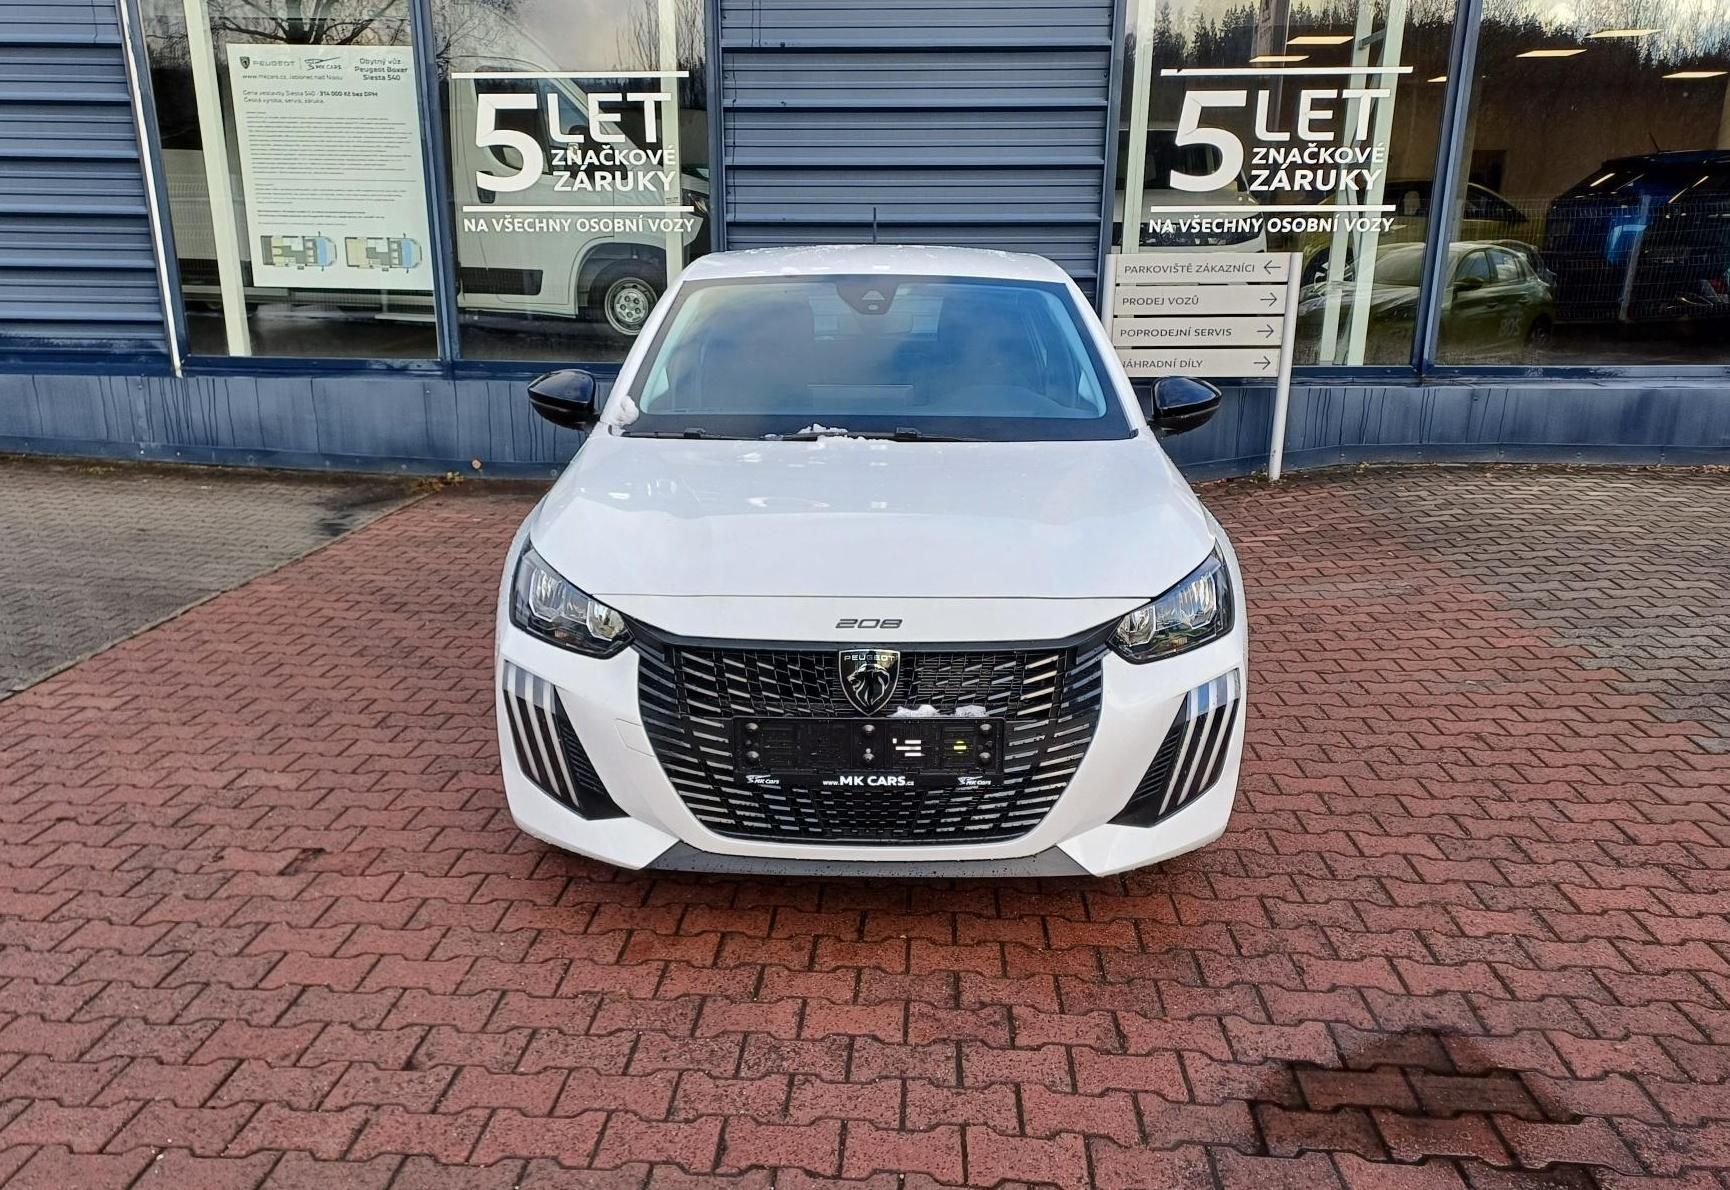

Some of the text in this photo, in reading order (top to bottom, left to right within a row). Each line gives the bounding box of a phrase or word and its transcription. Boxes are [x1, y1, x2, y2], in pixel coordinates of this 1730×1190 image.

[354, 66, 408, 74] Peugeot Boxer
[359, 57, 401, 66] Obytný vůz
[547, 92, 672, 144] LET
[1254, 89, 1391, 141] LET
[475, 93, 544, 192] 5
[1169, 90, 1247, 192] 5
[551, 144, 676, 166] ZNAČKOVÉ
[1251, 142, 1385, 165] ZNAČKOVÉ
[553, 164, 676, 192] ZÁRUKY
[1250, 159, 1382, 191] ZÁRUKY
[463, 214, 695, 233] NA VŠECHNY OSOBNÍ VOZY
[1148, 214, 1394, 233] NA VŠECHNY OSOBNÍ VOZY
[1124, 262, 1255, 274] PARKOVIŠTĚ ZÁKAZNÍCI
[1122, 295, 1199, 306] PRODEJ VOZŮ
[1120, 325, 1232, 338] POPRODEJNÍ SERVIS
[1179, 357, 1203, 368] DÍLY
[835, 618, 903, 629] 208
[844, 654, 896, 662] PEUGEOT
